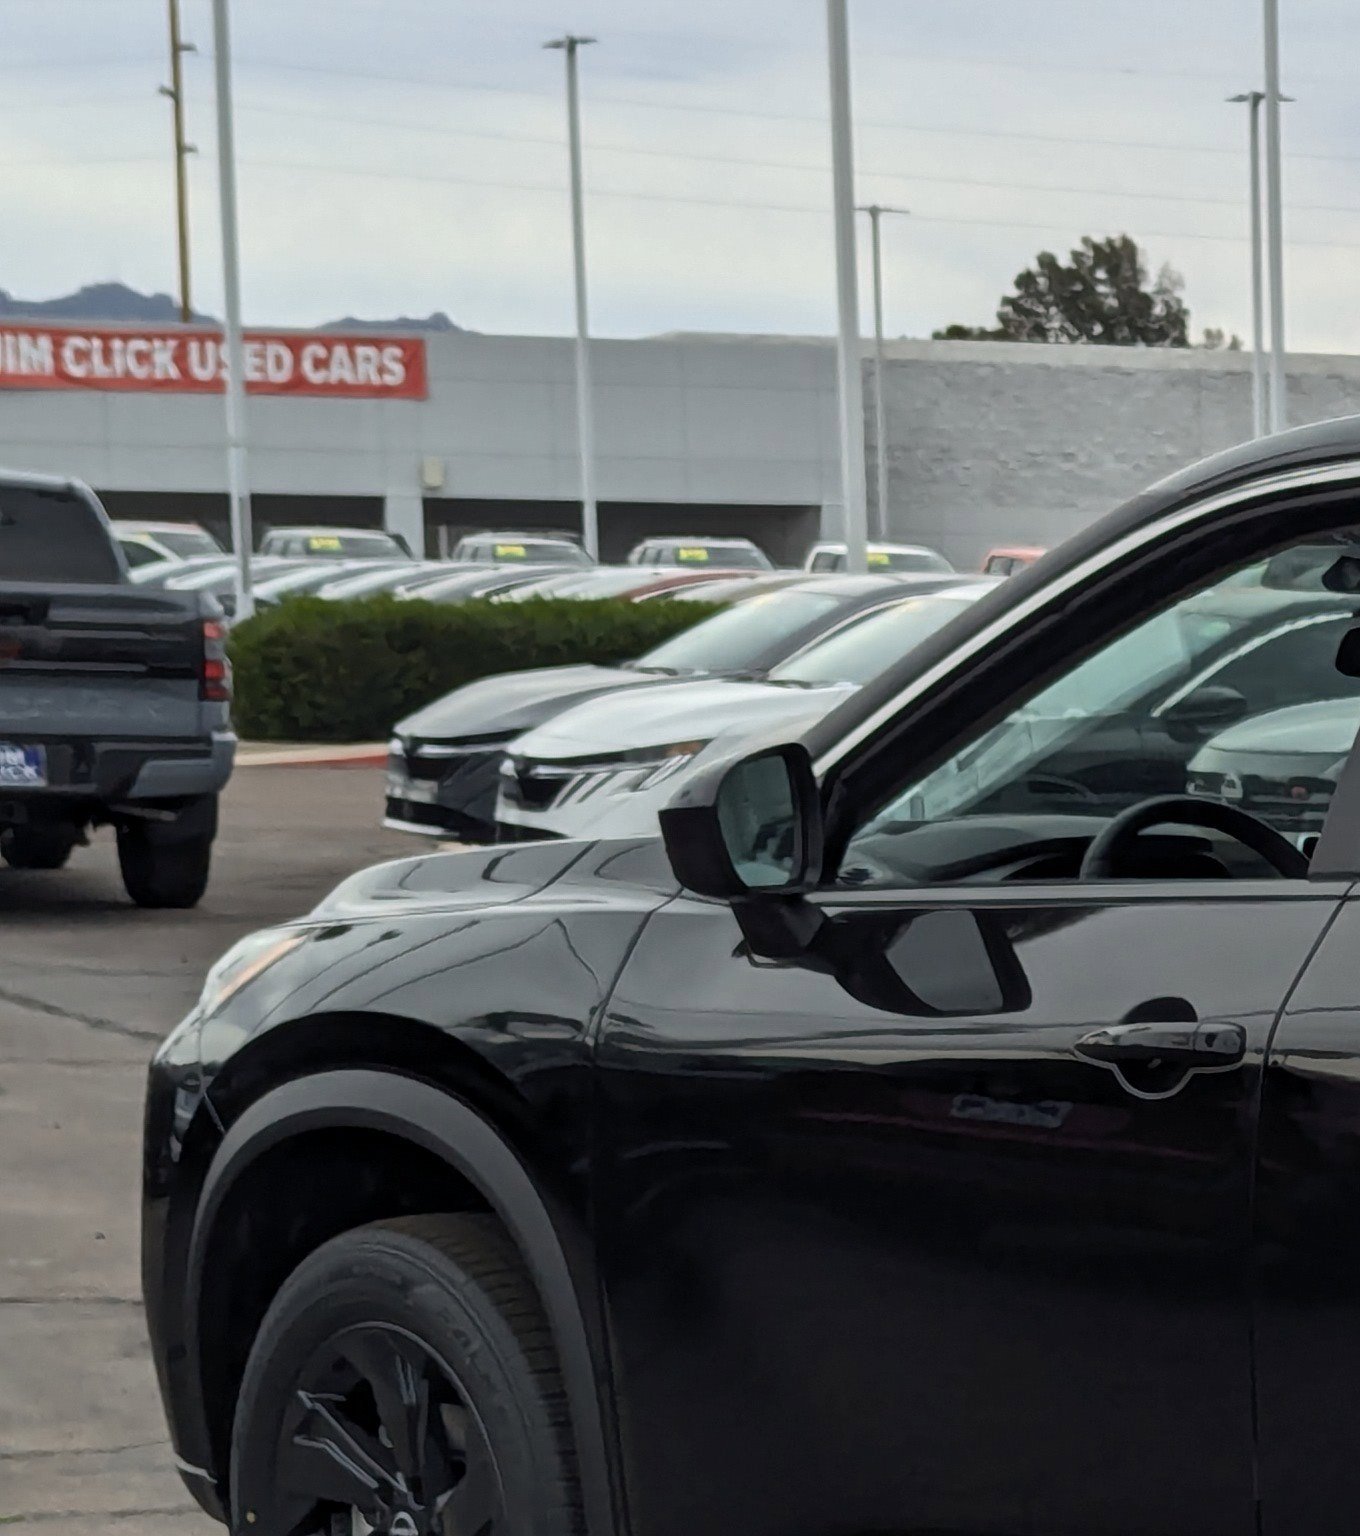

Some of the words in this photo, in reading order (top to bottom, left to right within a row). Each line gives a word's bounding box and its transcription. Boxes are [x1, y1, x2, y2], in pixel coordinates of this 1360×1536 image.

[0, 331, 55, 376] IM
[61, 335, 183, 380] CLICK
[302, 343, 406, 386] CARS
